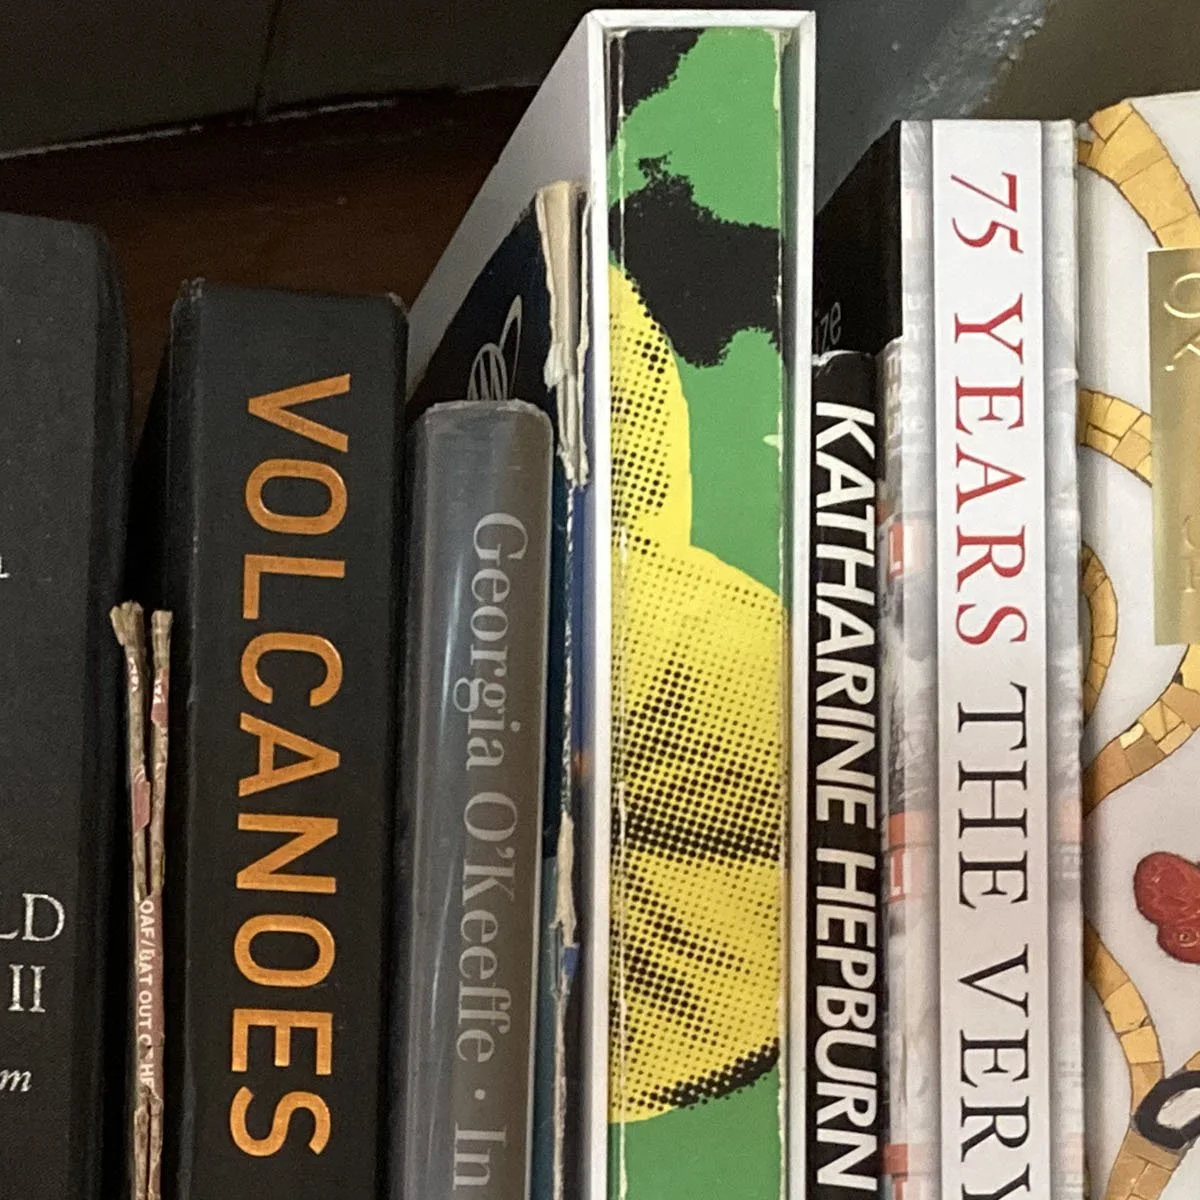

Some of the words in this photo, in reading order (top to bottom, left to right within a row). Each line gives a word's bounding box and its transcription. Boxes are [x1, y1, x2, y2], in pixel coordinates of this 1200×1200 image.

[951, 171, 1024, 254] 75
[954, 292, 1028, 646] YEARS
[453, 512, 528, 772] Georgia
[816, 402, 876, 830] KATHARINE
[228, 373, 351, 1157] VOLCANOES
[957, 681, 1029, 910] THE
[8, 964, 46, 1013] II
[138, 990, 153, 1034] OUT
[454, 790, 518, 1064] O'Keeffe
[815, 847, 878, 1191] HEPBURN
[452, 1123, 507, 1191] In
